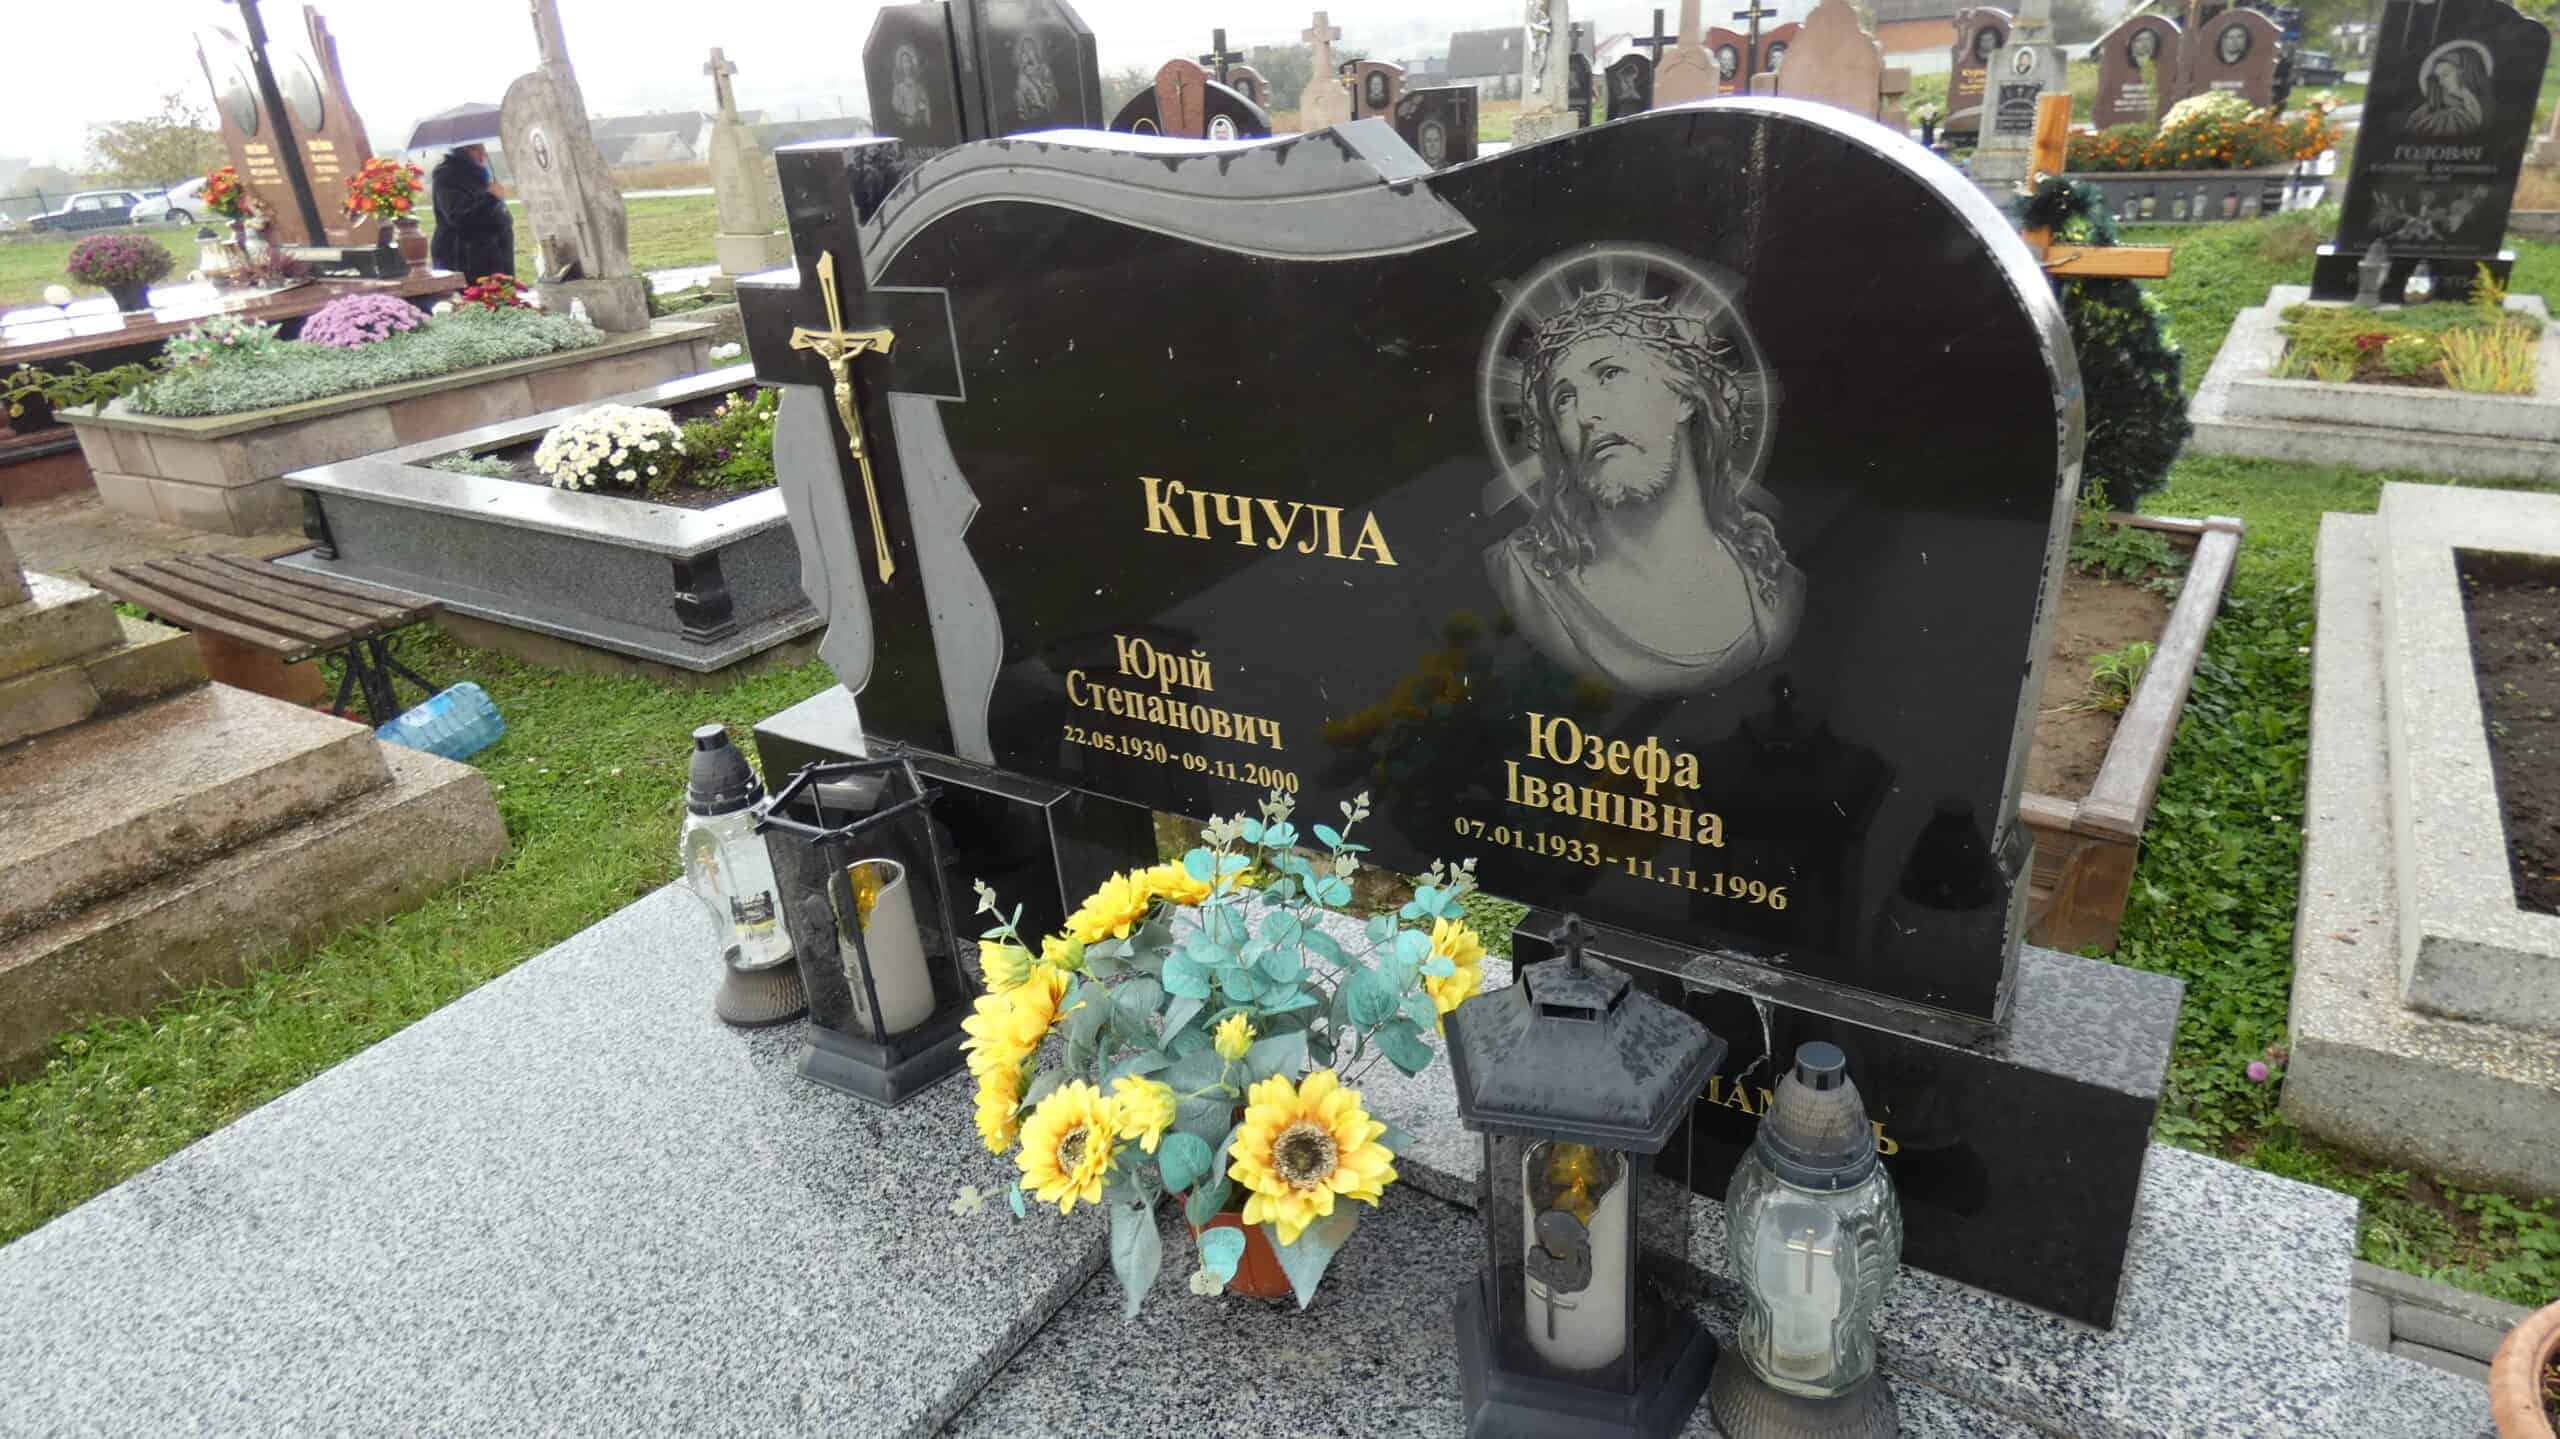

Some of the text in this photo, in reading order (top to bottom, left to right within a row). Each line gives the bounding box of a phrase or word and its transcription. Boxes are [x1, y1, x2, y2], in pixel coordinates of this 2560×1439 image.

[1138, 476, 1400, 567] КІЧУЛА
[1113, 633, 1216, 694] Юрій
[1065, 669, 1284, 751] Степанович
[1526, 711, 1701, 796] Юзефа
[1504, 759, 1725, 848] Іванівна
